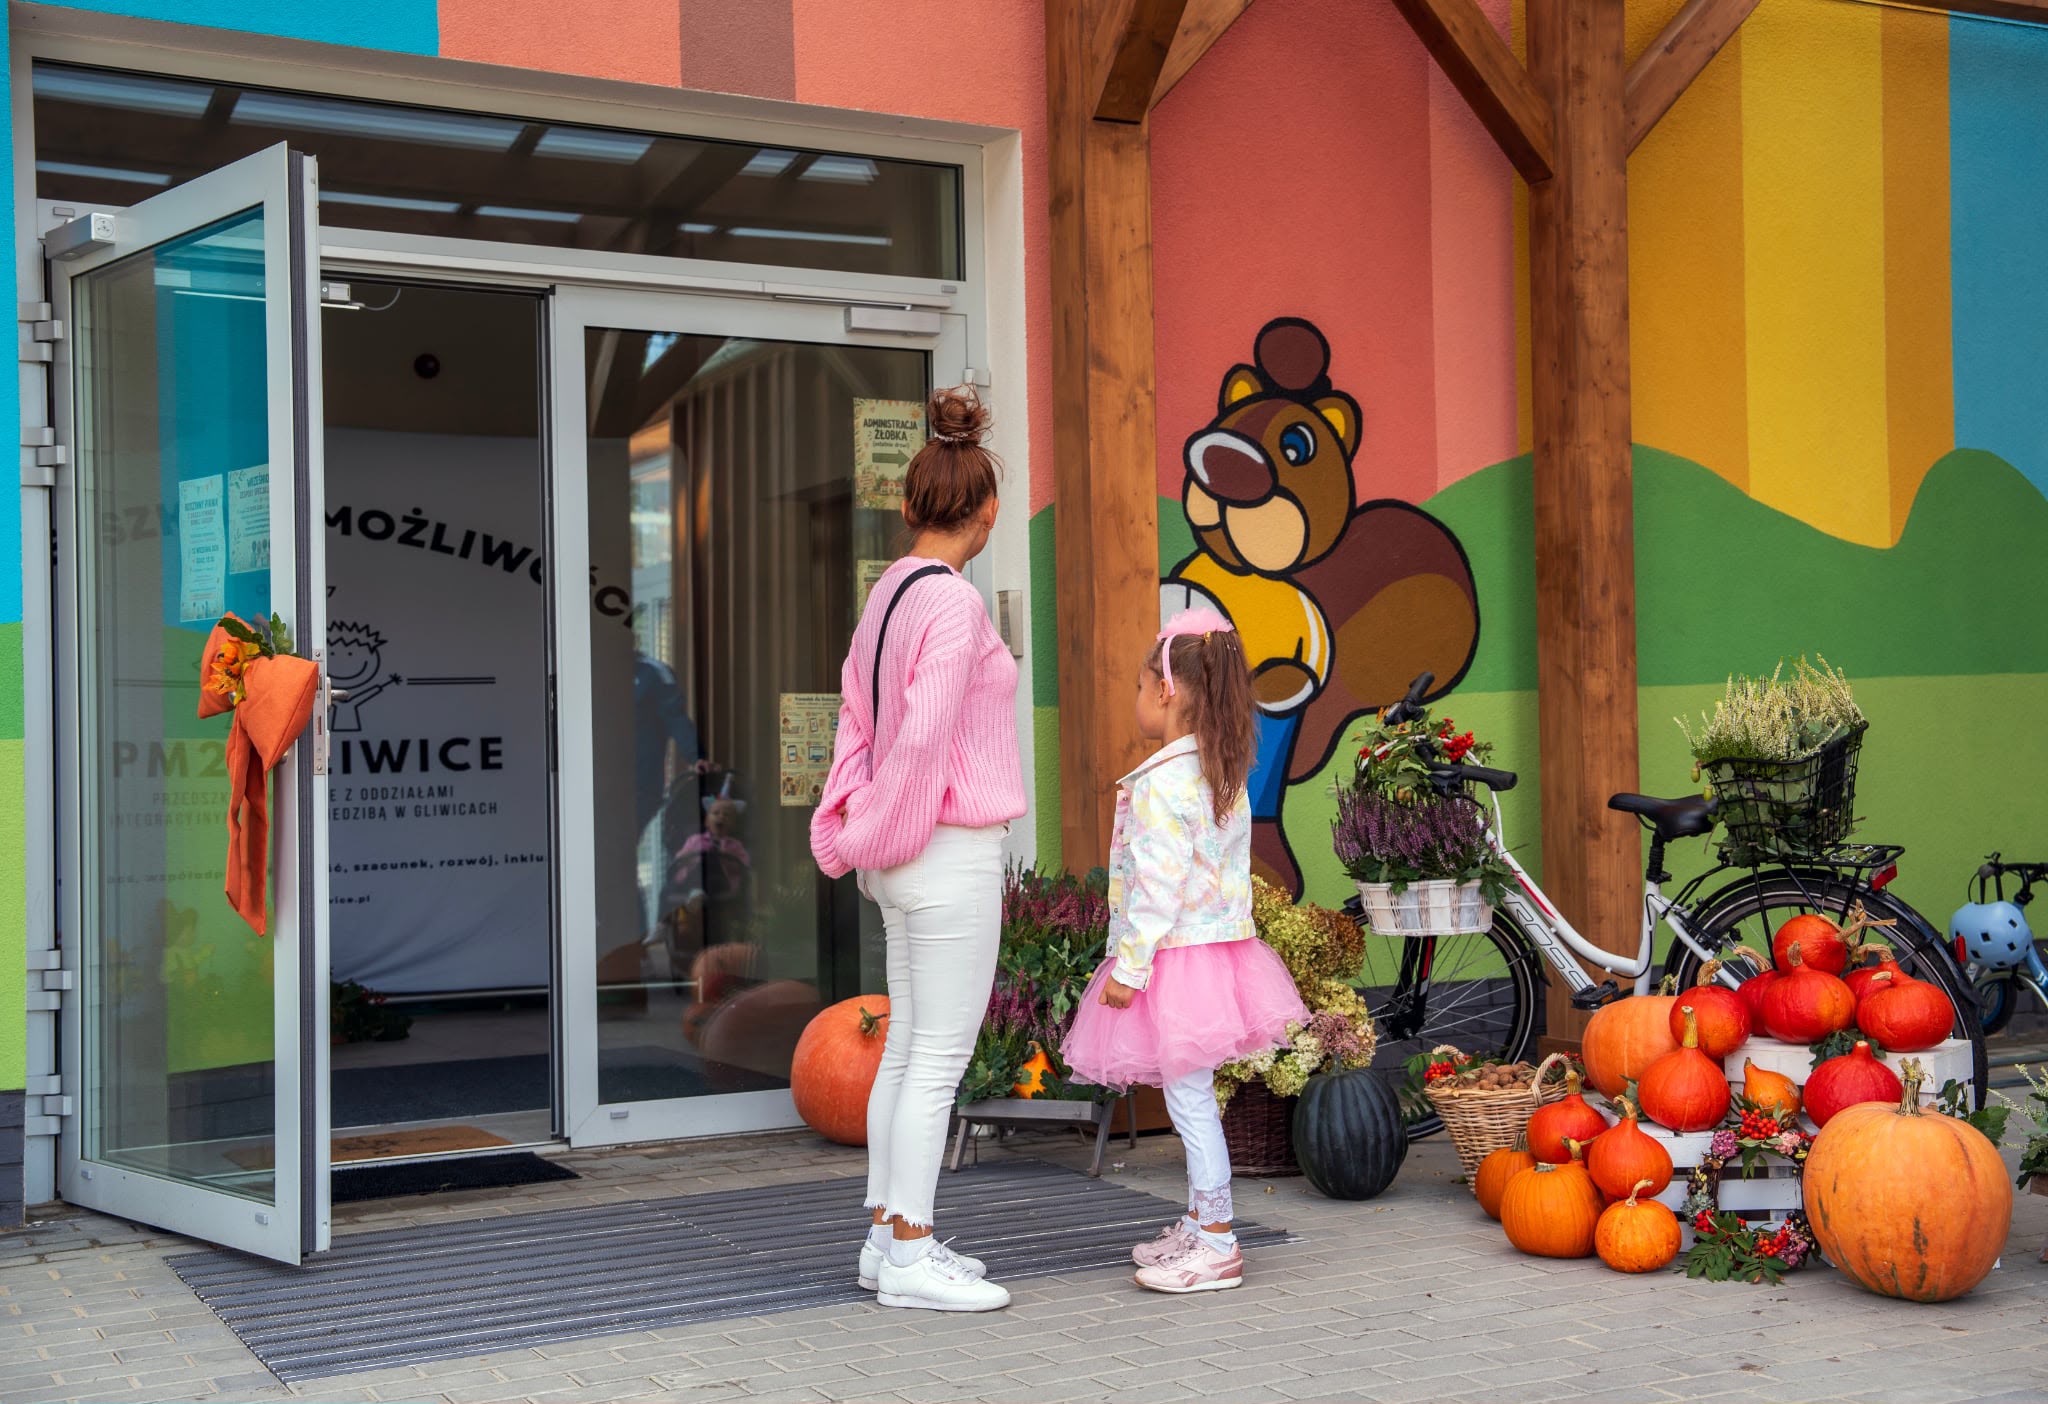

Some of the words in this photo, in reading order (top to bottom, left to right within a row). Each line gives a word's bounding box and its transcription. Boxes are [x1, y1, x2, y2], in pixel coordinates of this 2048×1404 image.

[863, 418, 918, 430] ADMINISTRACJA
[874, 428, 908, 441] ŻŁOBKA
[345, 787, 353, 802] Z
[360, 785, 454, 801] ODDZIAŁAMI
[395, 805, 407, 818] W
[414, 801, 498, 818] GLIWICACH
[503, 853, 545, 864] inklu
